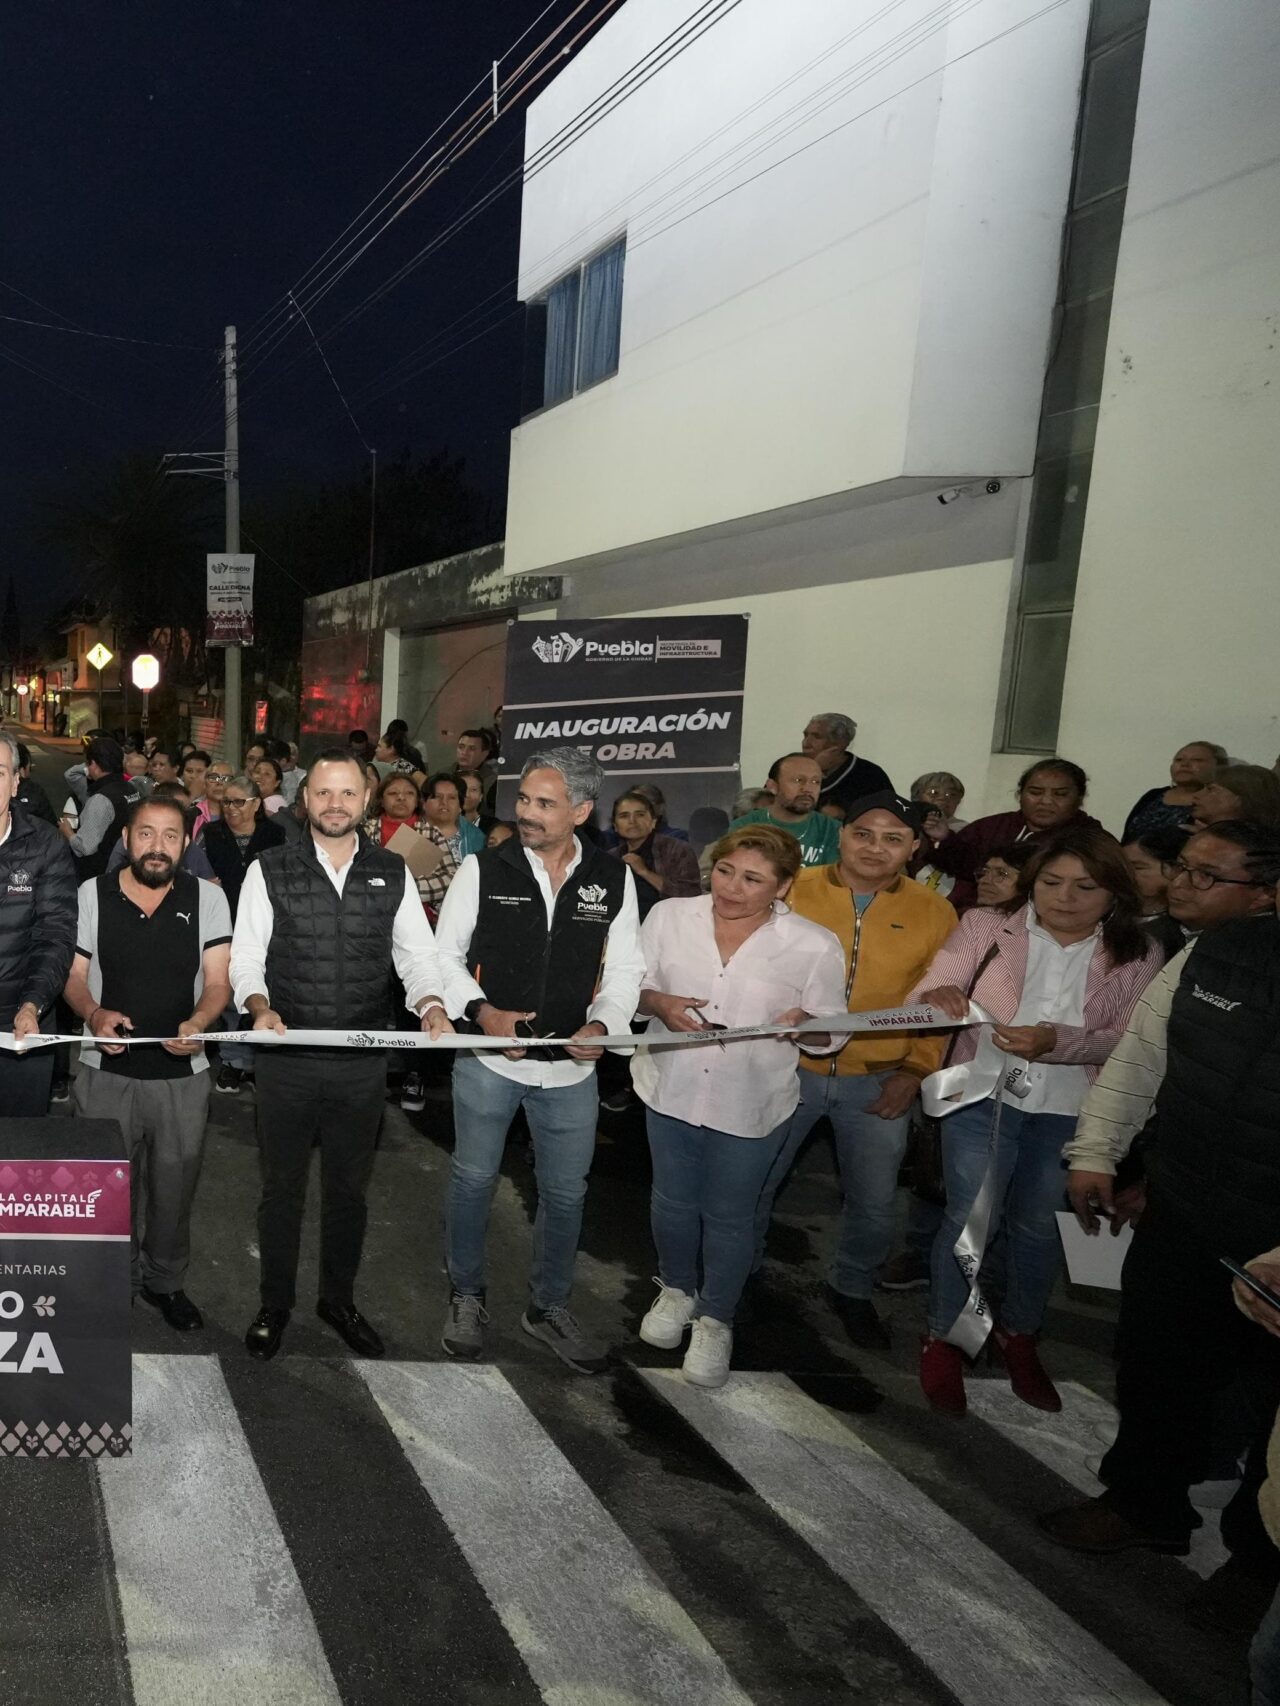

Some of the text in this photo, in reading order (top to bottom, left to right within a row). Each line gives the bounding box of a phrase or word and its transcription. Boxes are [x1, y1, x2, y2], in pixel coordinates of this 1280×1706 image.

[585, 640, 654, 656] Puebla
[514, 708, 732, 740] INAUGURACIÓN
[596, 742, 676, 762] OBRA
[577, 902, 608, 912] Puebla
[869, 1014, 934, 1027] IMPARABLE
[377, 1038, 417, 1048] Puebla
[0, 1193, 87, 1203] LA CAPITAL
